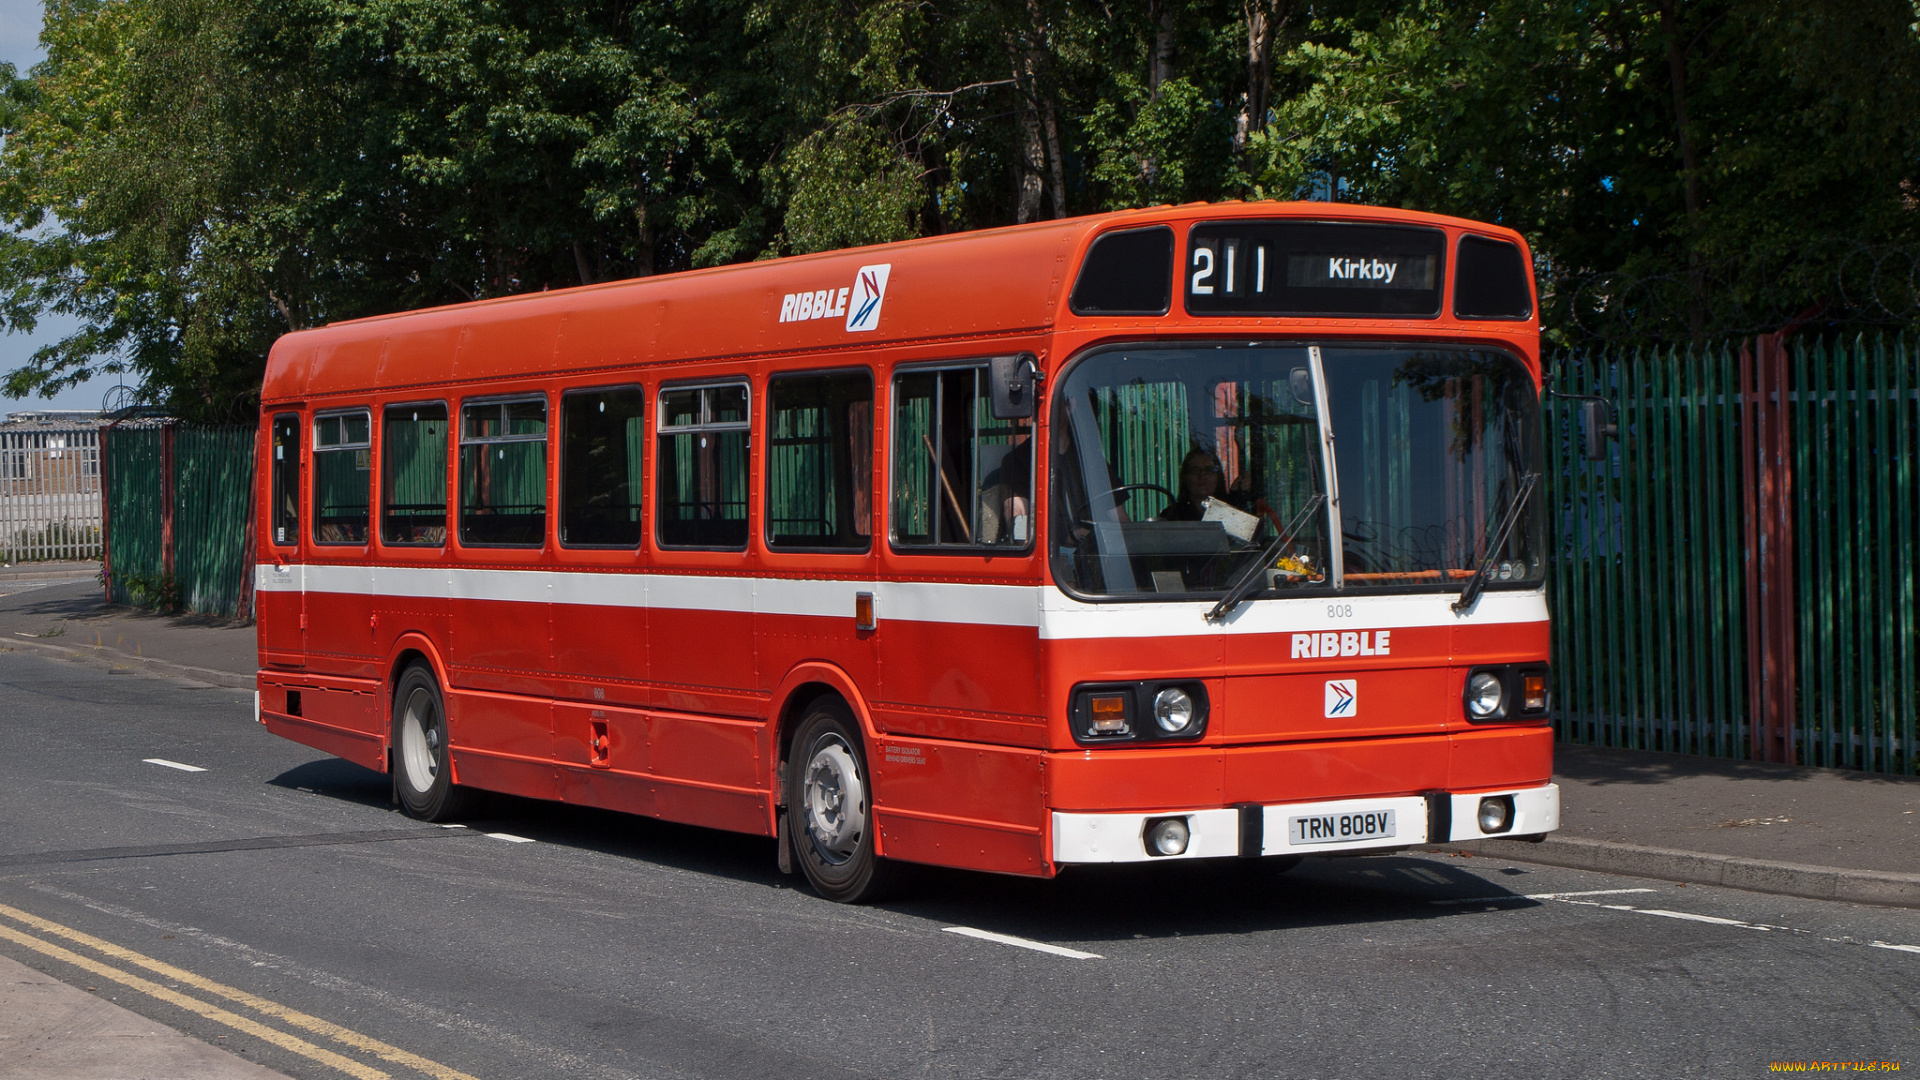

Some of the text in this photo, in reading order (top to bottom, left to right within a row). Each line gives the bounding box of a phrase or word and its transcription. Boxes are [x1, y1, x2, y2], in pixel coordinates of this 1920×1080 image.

[1192, 246, 1264, 294] 211
[1329, 258, 1397, 283] Kirkby
[779, 287, 849, 323] RIBBLE
[1327, 604, 1353, 618] 808
[1291, 630, 1390, 659] RIBBLE
[1297, 813, 1388, 839] TRN 808V
